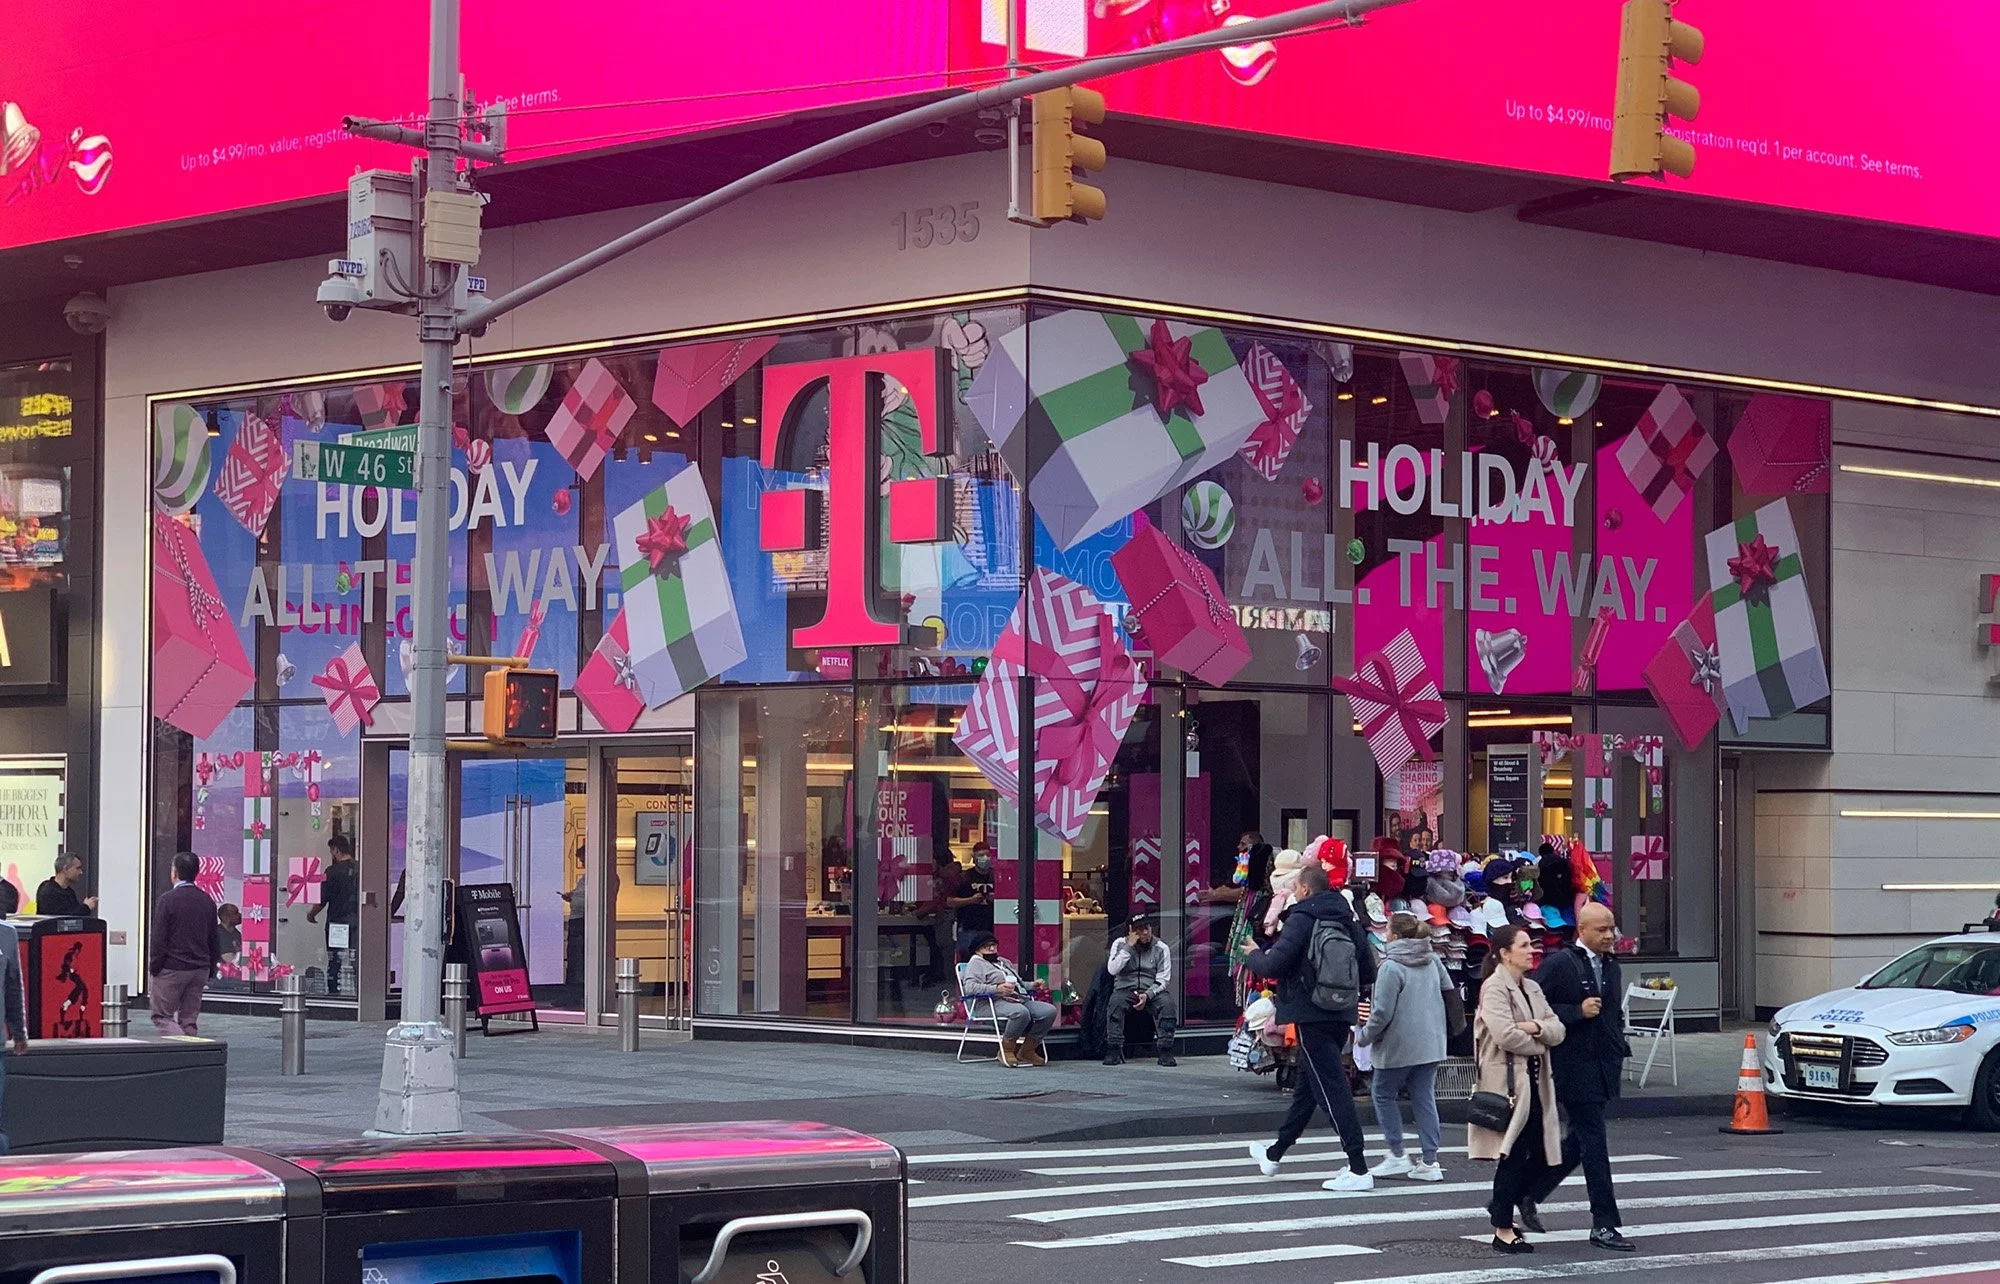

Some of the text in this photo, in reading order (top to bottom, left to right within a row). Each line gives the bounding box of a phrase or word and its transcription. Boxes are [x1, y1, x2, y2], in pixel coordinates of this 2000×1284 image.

[181, 154, 196, 171] Up
[198, 153, 210, 166] to
[212, 143, 267, 165] $4.99/mo.
[521, 88, 562, 107] terms.
[1506, 100, 1526, 121] Up
[1529, 104, 1543, 121] to
[1546, 103, 1613, 132] $4.99/mo.
[1736, 138, 1771, 157] req'd.
[1773, 140, 1780, 156] 1
[1783, 145, 1803, 161] per
[1806, 149, 1858, 169] account.
[1860, 153, 1883, 173] See
[1885, 160, 1923, 180] terms.
[891, 201, 980, 250] 1535
[337, 260, 363, 275] NYPD
[468, 277, 485, 290] YPD
[324, 449, 413, 483] W 46 St
[1339, 438, 1588, 528] HOLIDAY
[316, 458, 539, 540] HOLDAY
[760, 346, 953, 649] T
[1241, 528, 1667, 624] ALL. THE. WAY.
[240, 561, 342, 628] ALL.
[353, 558, 467, 624] TH.
[483, 542, 619, 617] WAY.
[822, 656, 849, 668] NETFLIX
[1400, 761, 1437, 772] SHARING
[1400, 772, 1438, 783] SHARING
[12, 788, 48, 801] BIGGEST
[0, 804, 49, 821] EPHORA
[25, 823, 48, 837] USA
[494, 985, 513, 994] ON US
[1811, 1014, 1865, 1023] POLICE
[1827, 1008, 1864, 1016] NYPD
[1809, 1070, 1831, 1082] 9169
